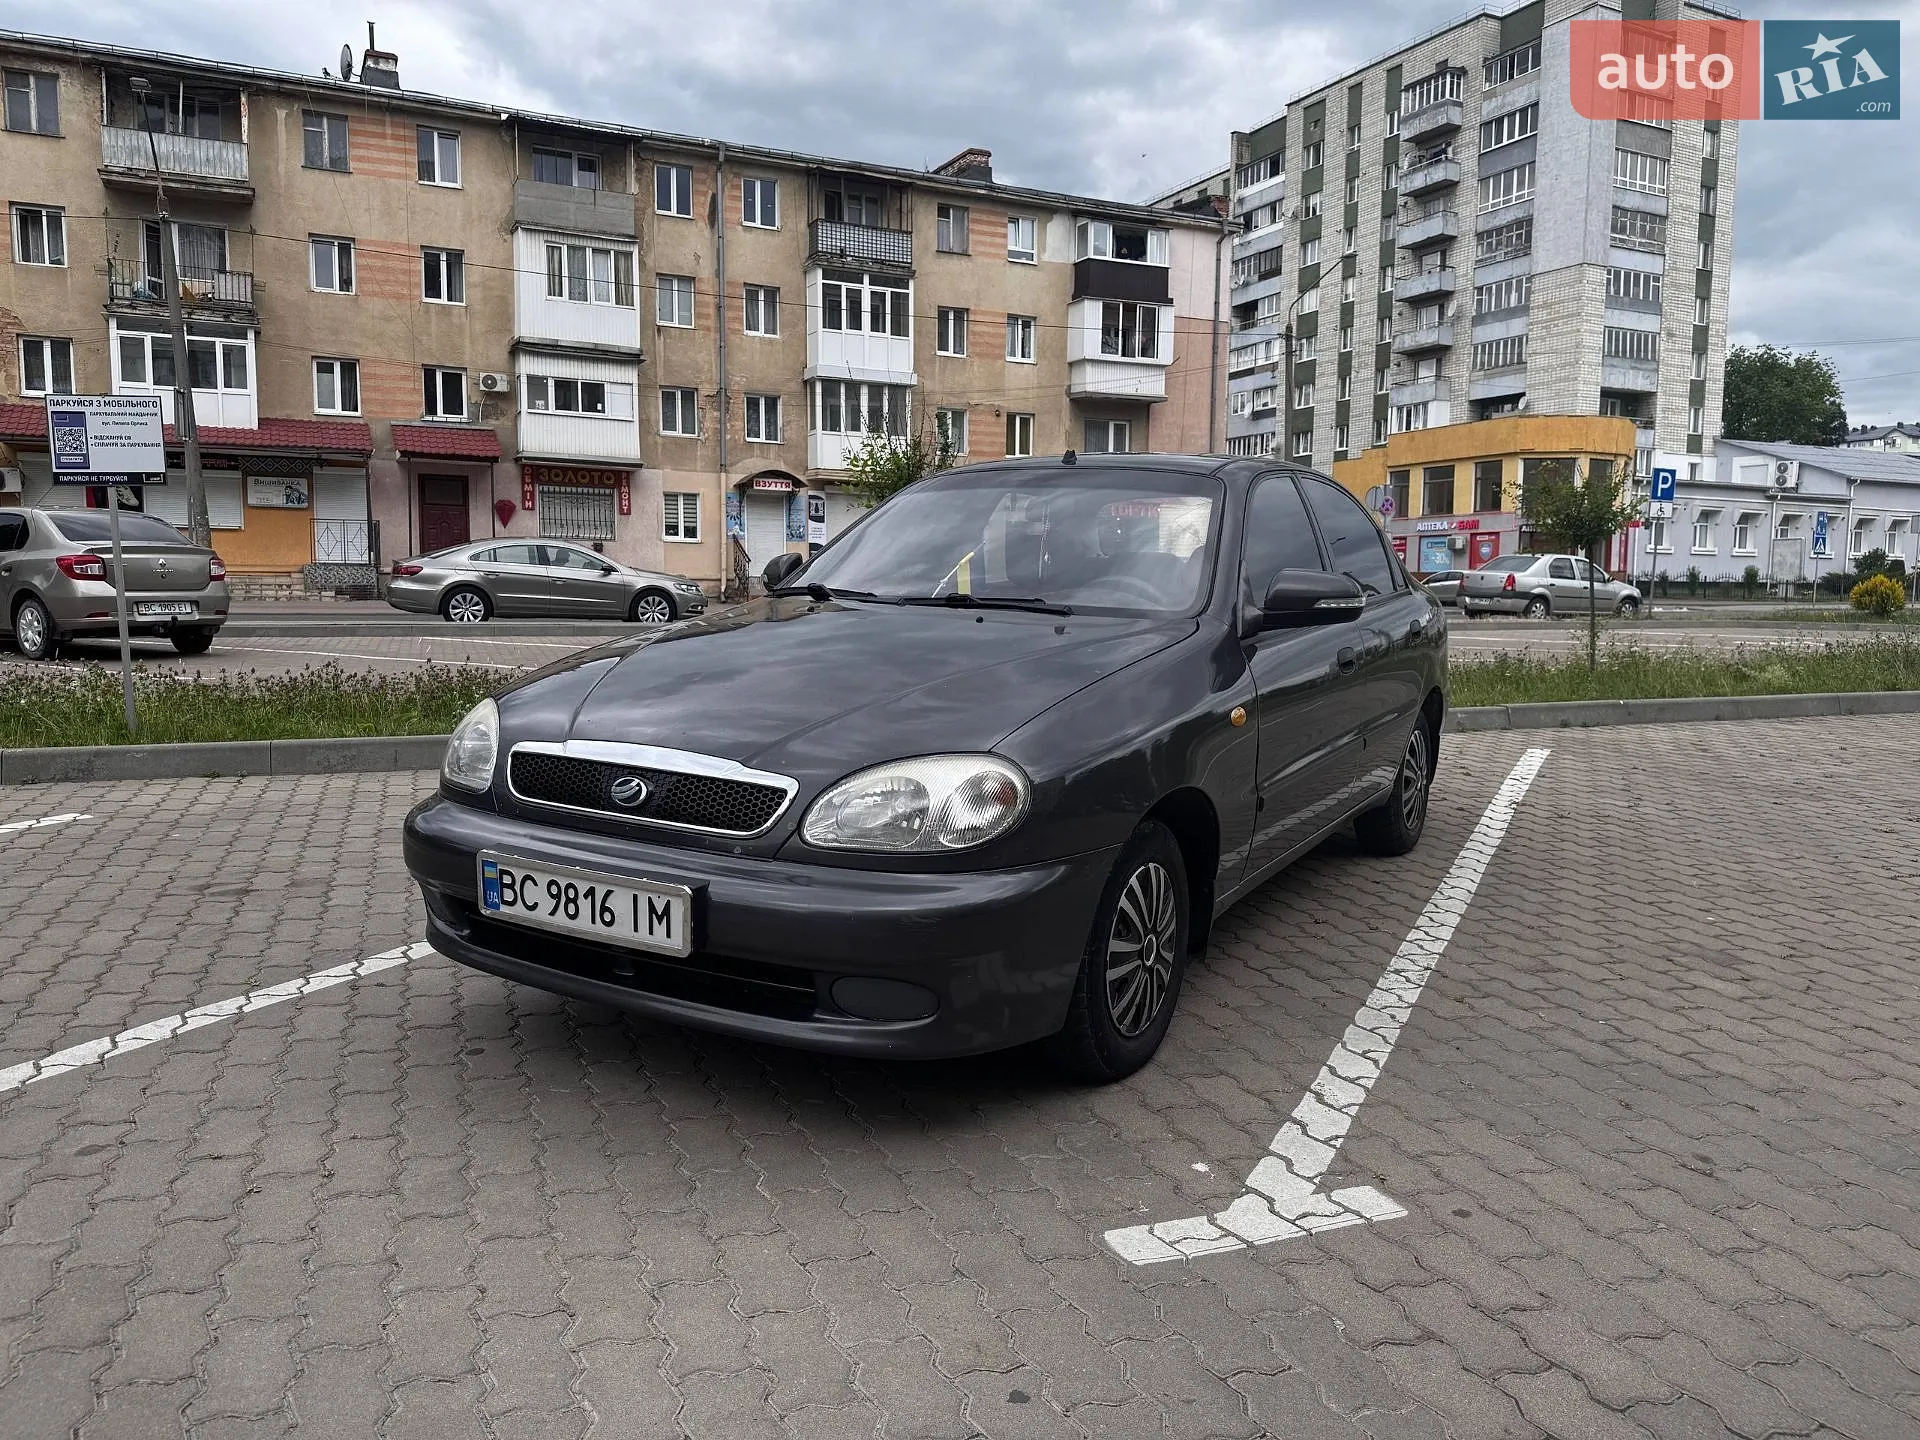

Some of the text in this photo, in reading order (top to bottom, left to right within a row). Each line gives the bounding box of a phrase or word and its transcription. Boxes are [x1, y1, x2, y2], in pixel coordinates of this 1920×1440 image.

[49, 398, 94, 408] ПАРКУЙСЯ
[103, 400, 158, 409] МОБІЛЬНОГО
[540, 468, 615, 485] ЗОЛОТО
[524, 466, 533, 509] ОБМІН
[755, 480, 791, 489] ВЗУТТЯ
[1657, 472, 1673, 497] P
[1416, 521, 1448, 531] АПТЕКА
[143, 603, 157, 612] BC
[158, 603, 176, 611] 1905
[487, 890, 500, 904] UA
[498, 867, 671, 939] BC 9816 IM
